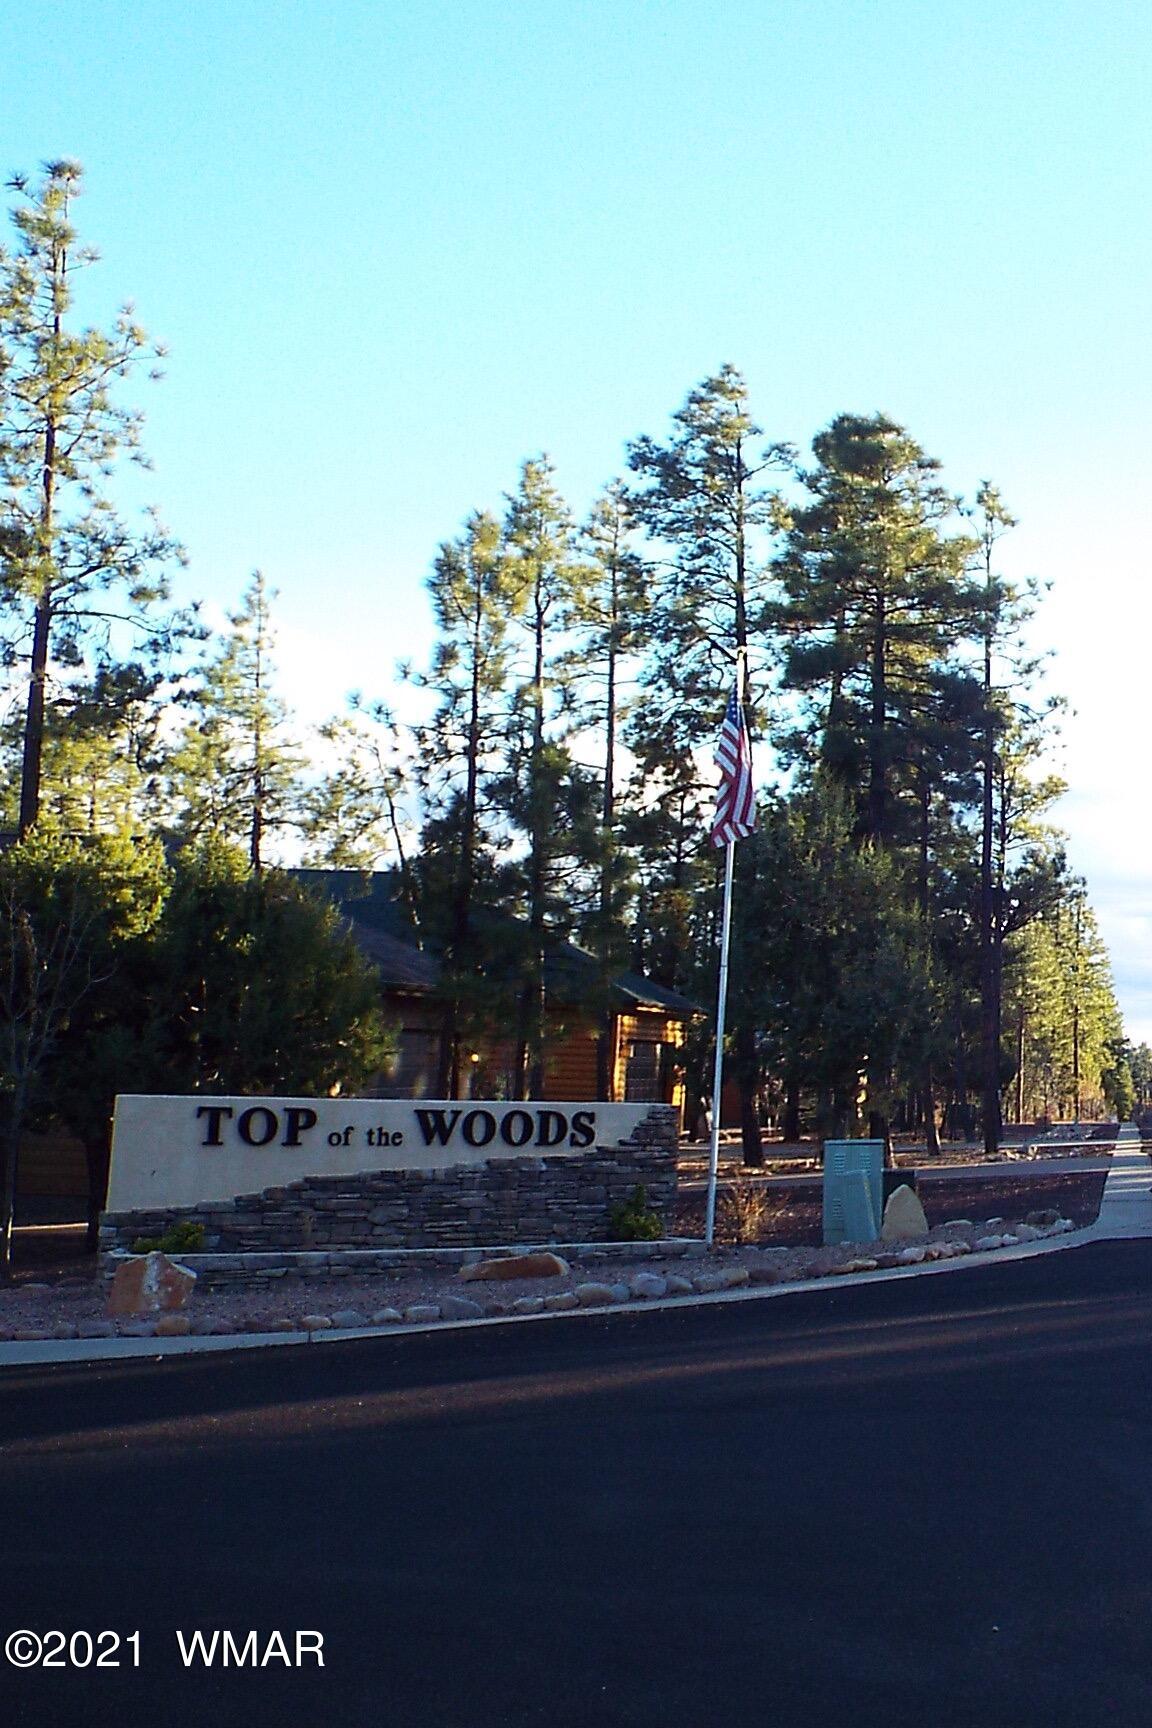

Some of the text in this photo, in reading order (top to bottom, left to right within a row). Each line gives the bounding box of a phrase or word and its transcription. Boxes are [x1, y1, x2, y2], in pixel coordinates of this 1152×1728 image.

[197, 1106, 597, 1148] TOP of the WOODS
